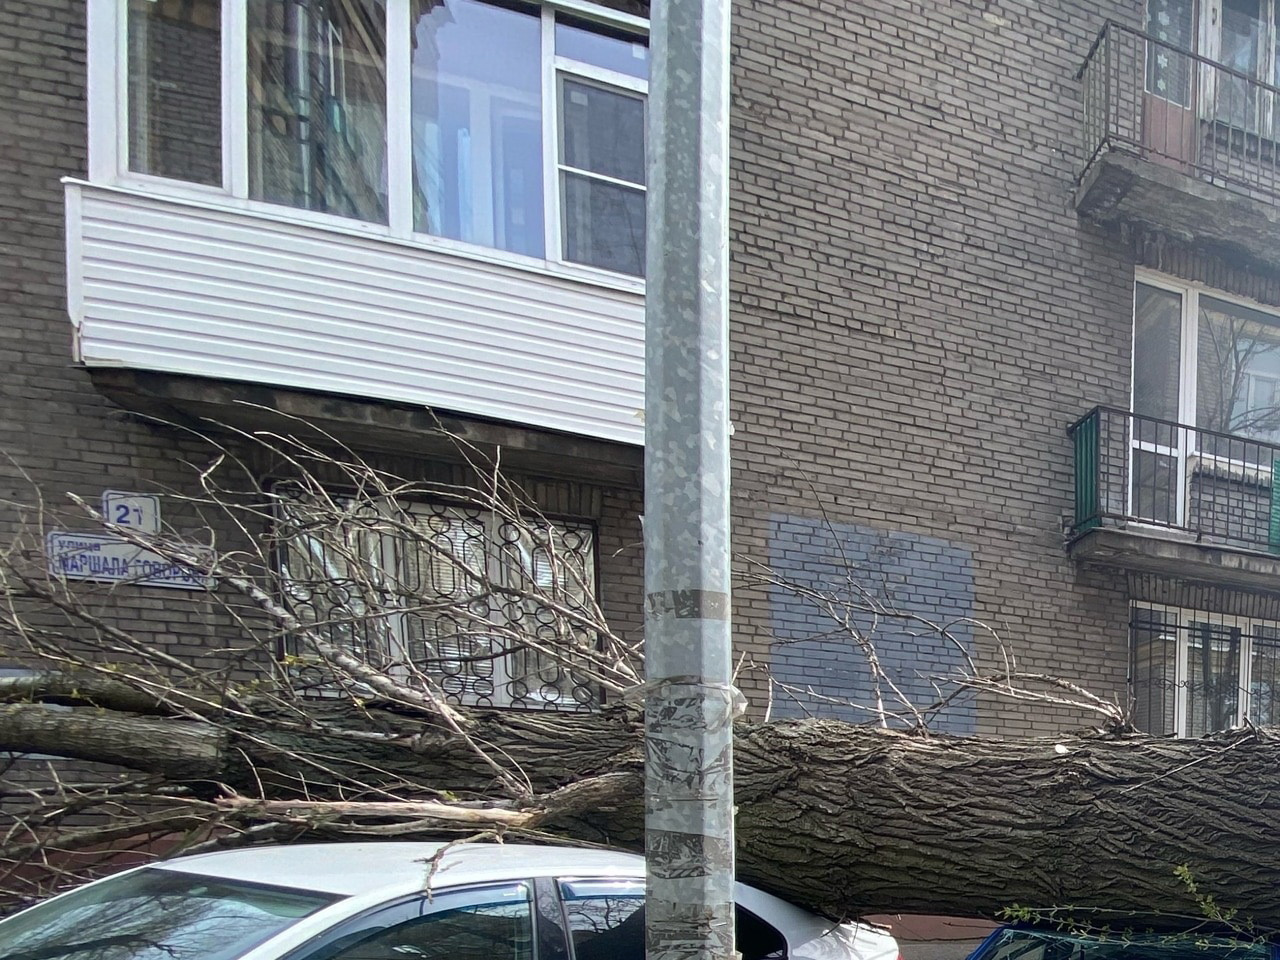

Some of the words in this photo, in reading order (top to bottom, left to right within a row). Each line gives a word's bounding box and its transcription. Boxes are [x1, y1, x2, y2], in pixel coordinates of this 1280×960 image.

[115, 504, 143, 525] 21
[58, 540, 101, 552] улица
[58, 553, 129, 576] МАРШАЛА
[135, 559, 206, 585] ГОВОРО
